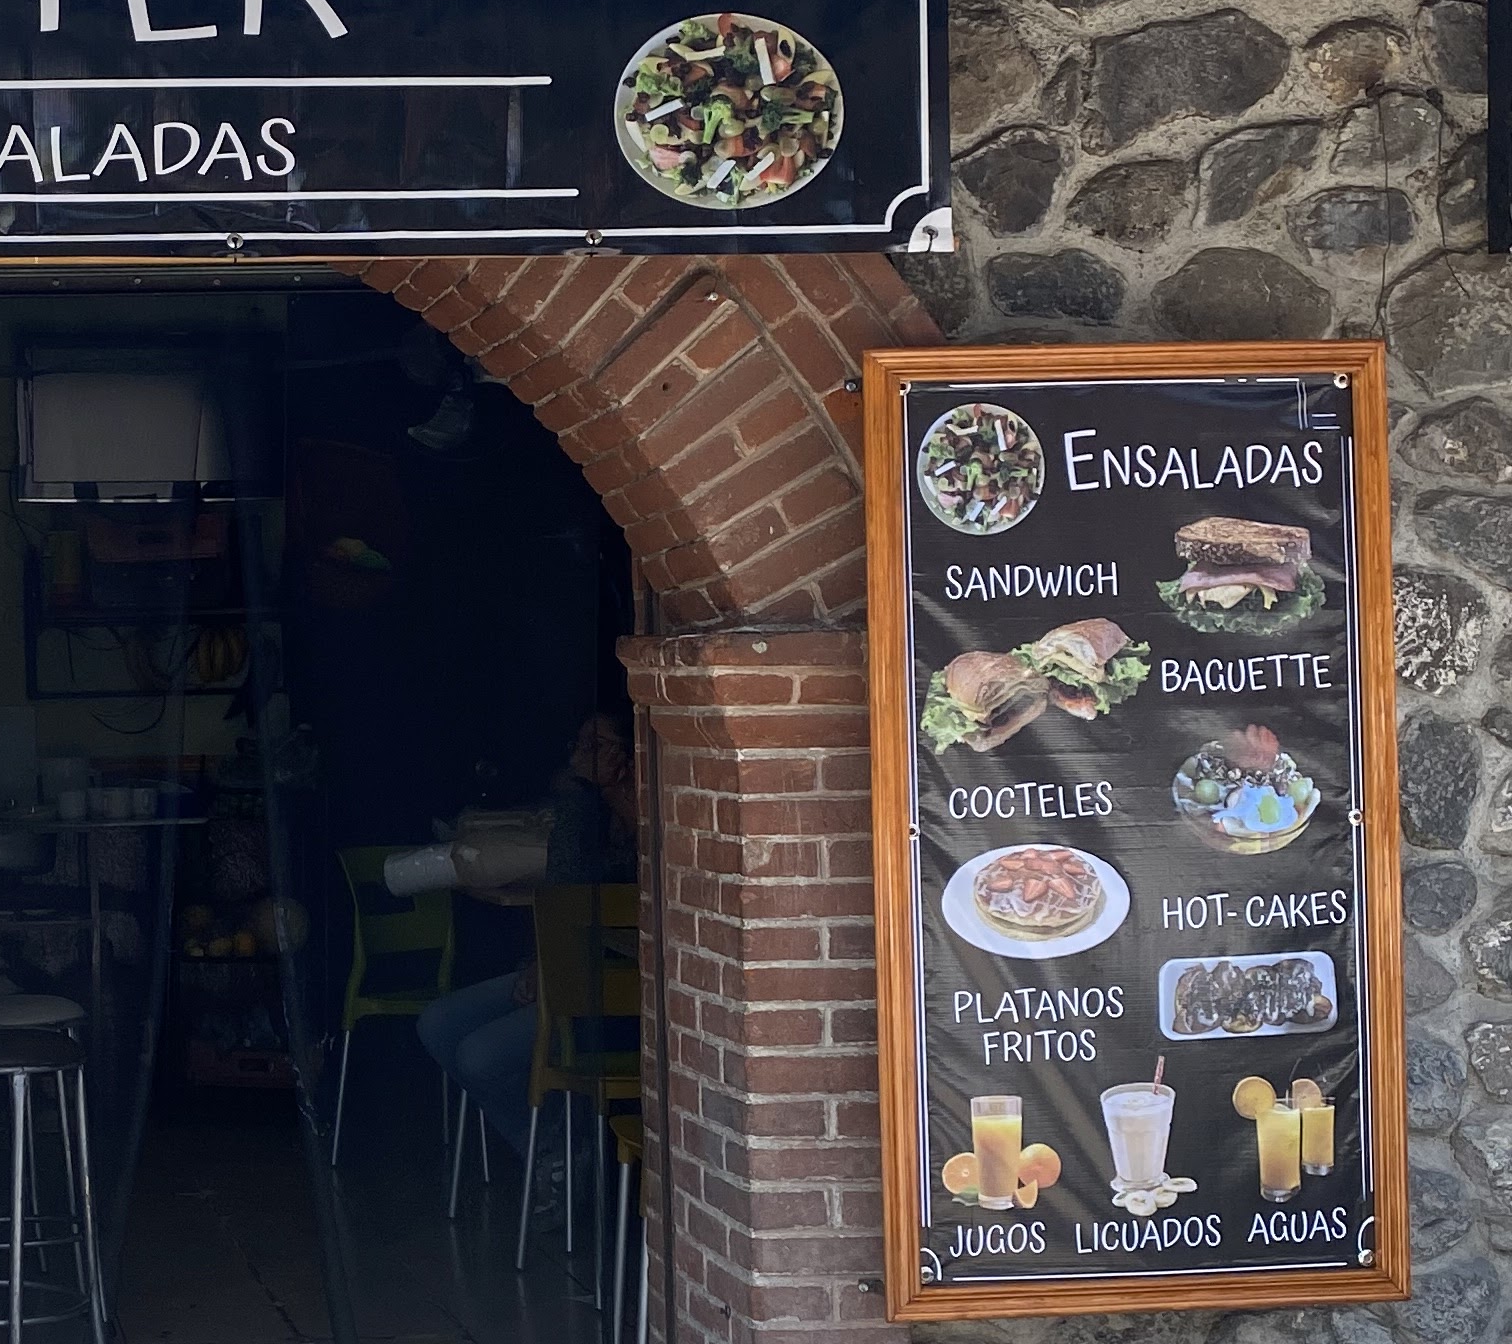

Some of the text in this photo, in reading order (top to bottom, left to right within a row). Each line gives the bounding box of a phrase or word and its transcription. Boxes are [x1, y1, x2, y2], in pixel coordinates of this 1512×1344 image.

[1063, 429, 1324, 492] ENSALADAS
[944, 561, 1119, 602] SANDWICH
[1160, 654, 1332, 695] BAGUETTE
[948, 781, 1114, 820] COCTELES
[953, 985, 1125, 1024] PLATANOS
[982, 1028, 1097, 1066] FRITOS
[949, 1221, 1047, 1259] JUGOS
[1075, 1214, 1223, 1255] LICUADOS
[1247, 1207, 1348, 1244] AGUAS
